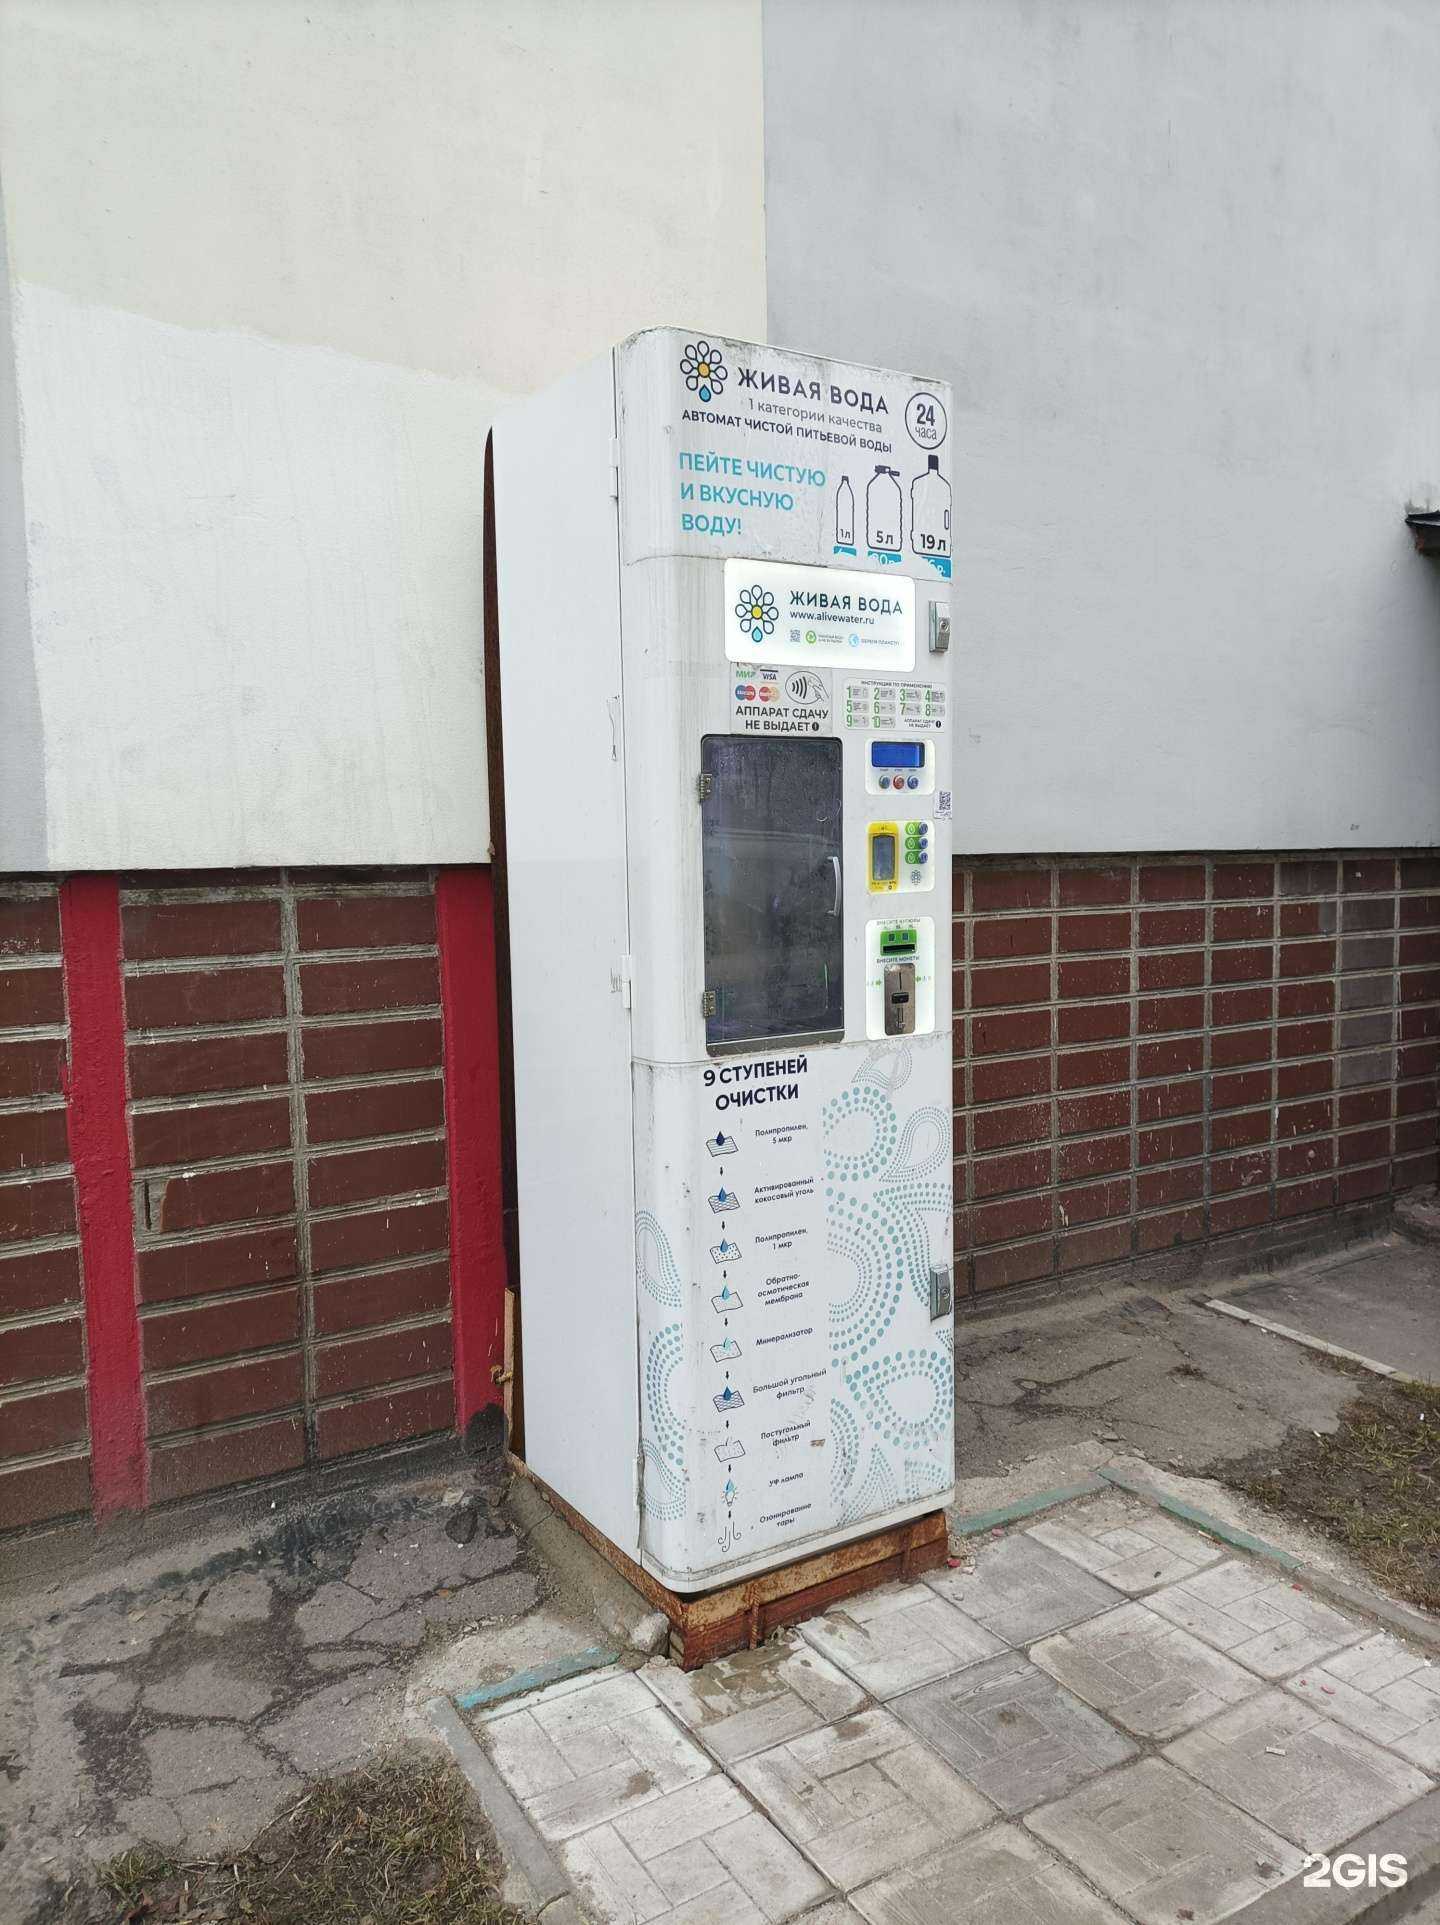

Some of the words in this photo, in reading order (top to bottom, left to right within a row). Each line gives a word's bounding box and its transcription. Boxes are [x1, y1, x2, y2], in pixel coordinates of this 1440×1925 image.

[737, 367, 821, 400] ЖИВАЯ
[830, 385, 889, 414] ВОДА
[748, 398, 754, 410] 1
[757, 402, 825, 422] категории
[828, 415, 882, 434] качества
[916, 403, 936, 427] 24
[682, 409, 741, 428] АВТОМАТ
[744, 418, 793, 436] ЧИСТОЙ
[796, 425, 857, 447] ПИТЬЕВОЙ
[859, 440, 892, 454] ВОДЫ
[914, 425, 938, 441] часа
[679, 451, 742, 476] ПЕЙТЕ
[746, 459, 826, 488] ЧИСТУЮ
[680, 483, 694, 500] И
[699, 484, 794, 511] ВКУСНУЮ
[681, 513, 742, 537] ВОДУ!
[789, 590, 851, 610] ЖИВАЯ
[858, 597, 903, 615] ВОДА
[789, 610, 875, 625] www.alivewater.ru
[762, 673, 777, 681] VISA
[846, 686, 852, 699] 1
[873, 687, 880, 701] 2
[899, 688, 906, 702] 3
[924, 690, 931, 703] 4
[735, 705, 790, 718] АППАРАТ
[792, 707, 829, 720] СДАЧУ
[846, 700, 853, 713] 5
[873, 701, 880, 715] 6
[899, 702, 906, 716] 7
[745, 719, 761, 730] НЕ
[763, 720, 811, 732] ВЫДАЕТ
[846, 714, 853, 728] 9
[703, 1069, 716, 1087] 9
[719, 1054, 808, 1084] СТУПЕНЕЙ
[715, 1084, 799, 1111] ОЧИСТКИ
[772, 1136, 778, 1145] 5
[778, 1135, 793, 1144] мкр
[754, 1176, 814, 1194] Активированный
[754, 1190, 794, 1204] кокосовый
[795, 1188, 814, 1198] уголь
[777, 1241, 793, 1250] мкр
[757, 1280, 810, 1298] осмотическая
[764, 1292, 804, 1306] мембрана
[755, 1326, 814, 1346] Минерализатор
[752, 1377, 789, 1394] Большой
[790, 1367, 828, 1386] угольный
[776, 1386, 805, 1400] фильтр
[760, 1419, 811, 1440] Постугольный
[772, 1434, 800, 1447] фильтр
[780, 1472, 804, 1484] лампа
[759, 1503, 812, 1524] Озонирование
[776, 1517, 796, 1528] тары
